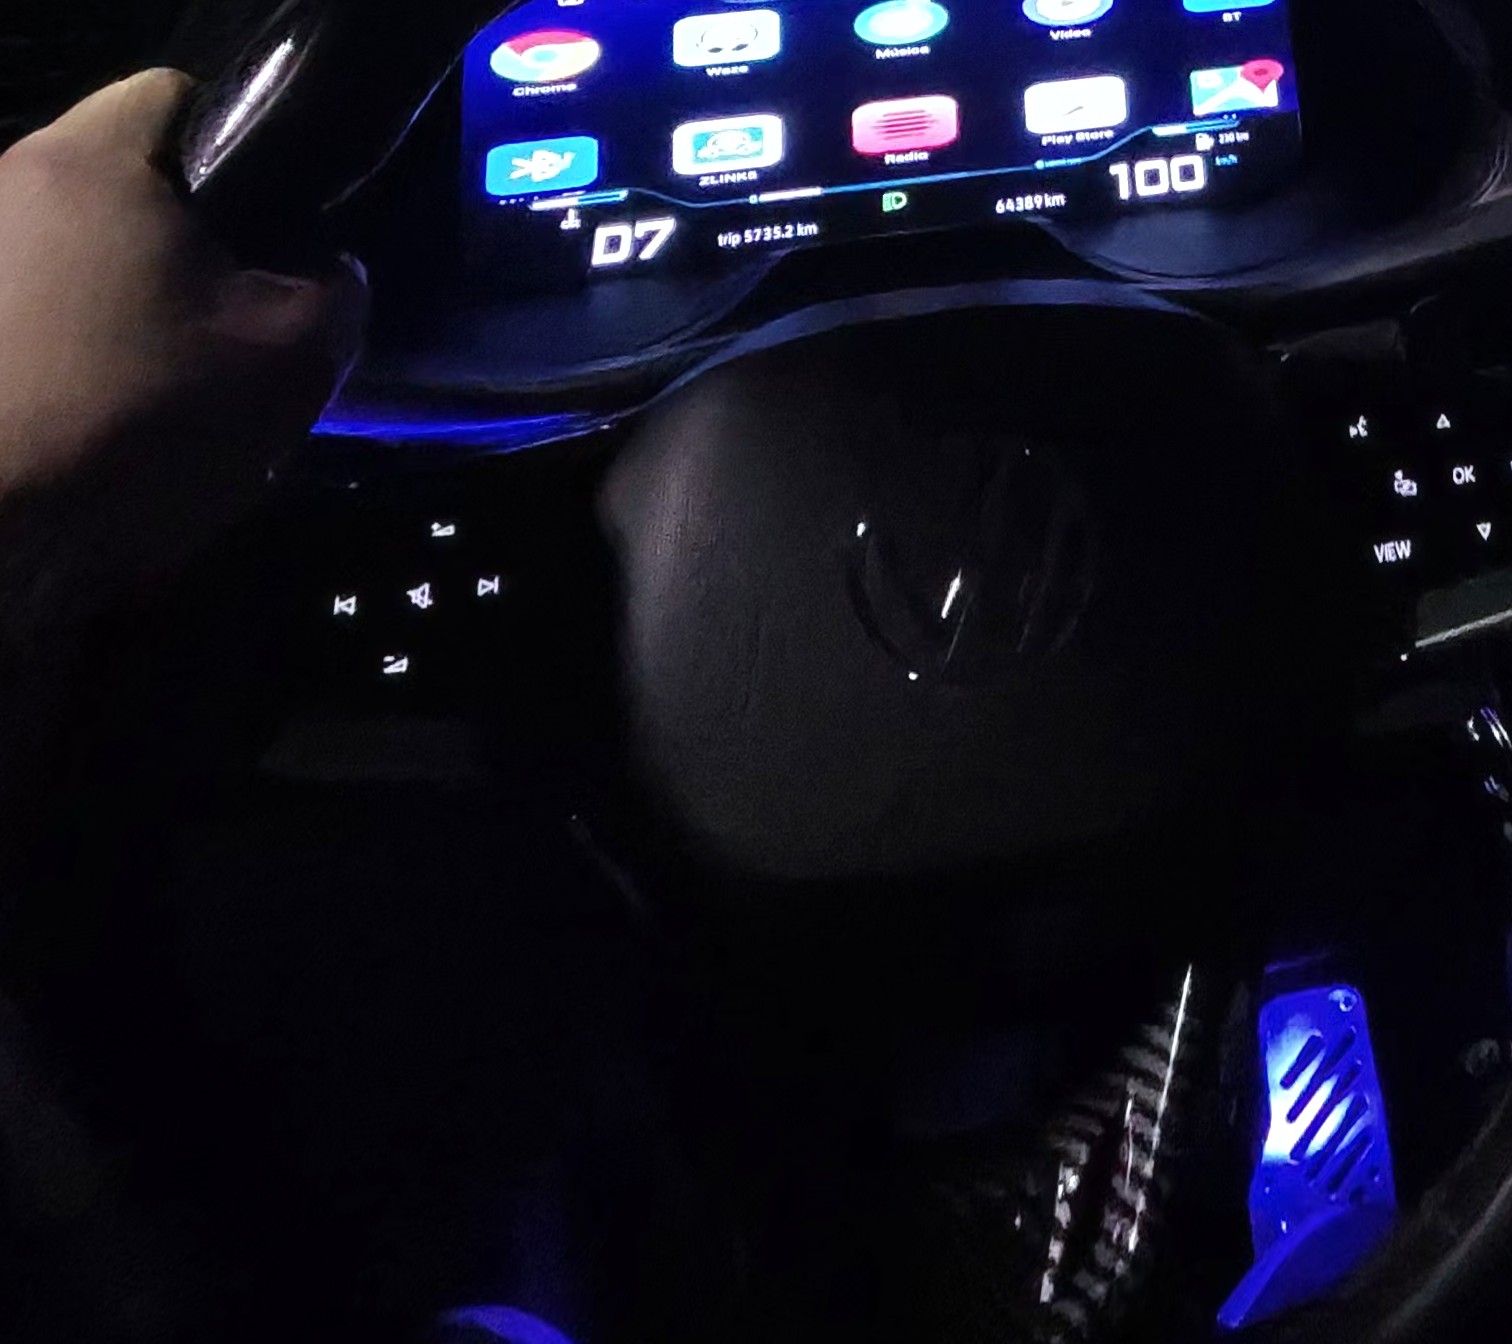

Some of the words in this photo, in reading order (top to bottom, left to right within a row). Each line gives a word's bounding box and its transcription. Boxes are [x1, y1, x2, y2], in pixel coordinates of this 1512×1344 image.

[706, 65, 748, 76] Waze
[512, 82, 577, 96] Chrome
[1041, 134, 1073, 147] Play
[1076, 129, 1114, 143] Store
[884, 152, 929, 165] Radio
[1109, 154, 1206, 201] 100
[996, 194, 1042, 214] 64389
[1044, 193, 1067, 208] km
[591, 216, 677, 268] D7
[718, 231, 742, 248] trip
[744, 224, 794, 243] 5735.2
[796, 222, 819, 237] km
[1453, 465, 1475, 485] OK
[1374, 539, 1411, 563] VIEW
